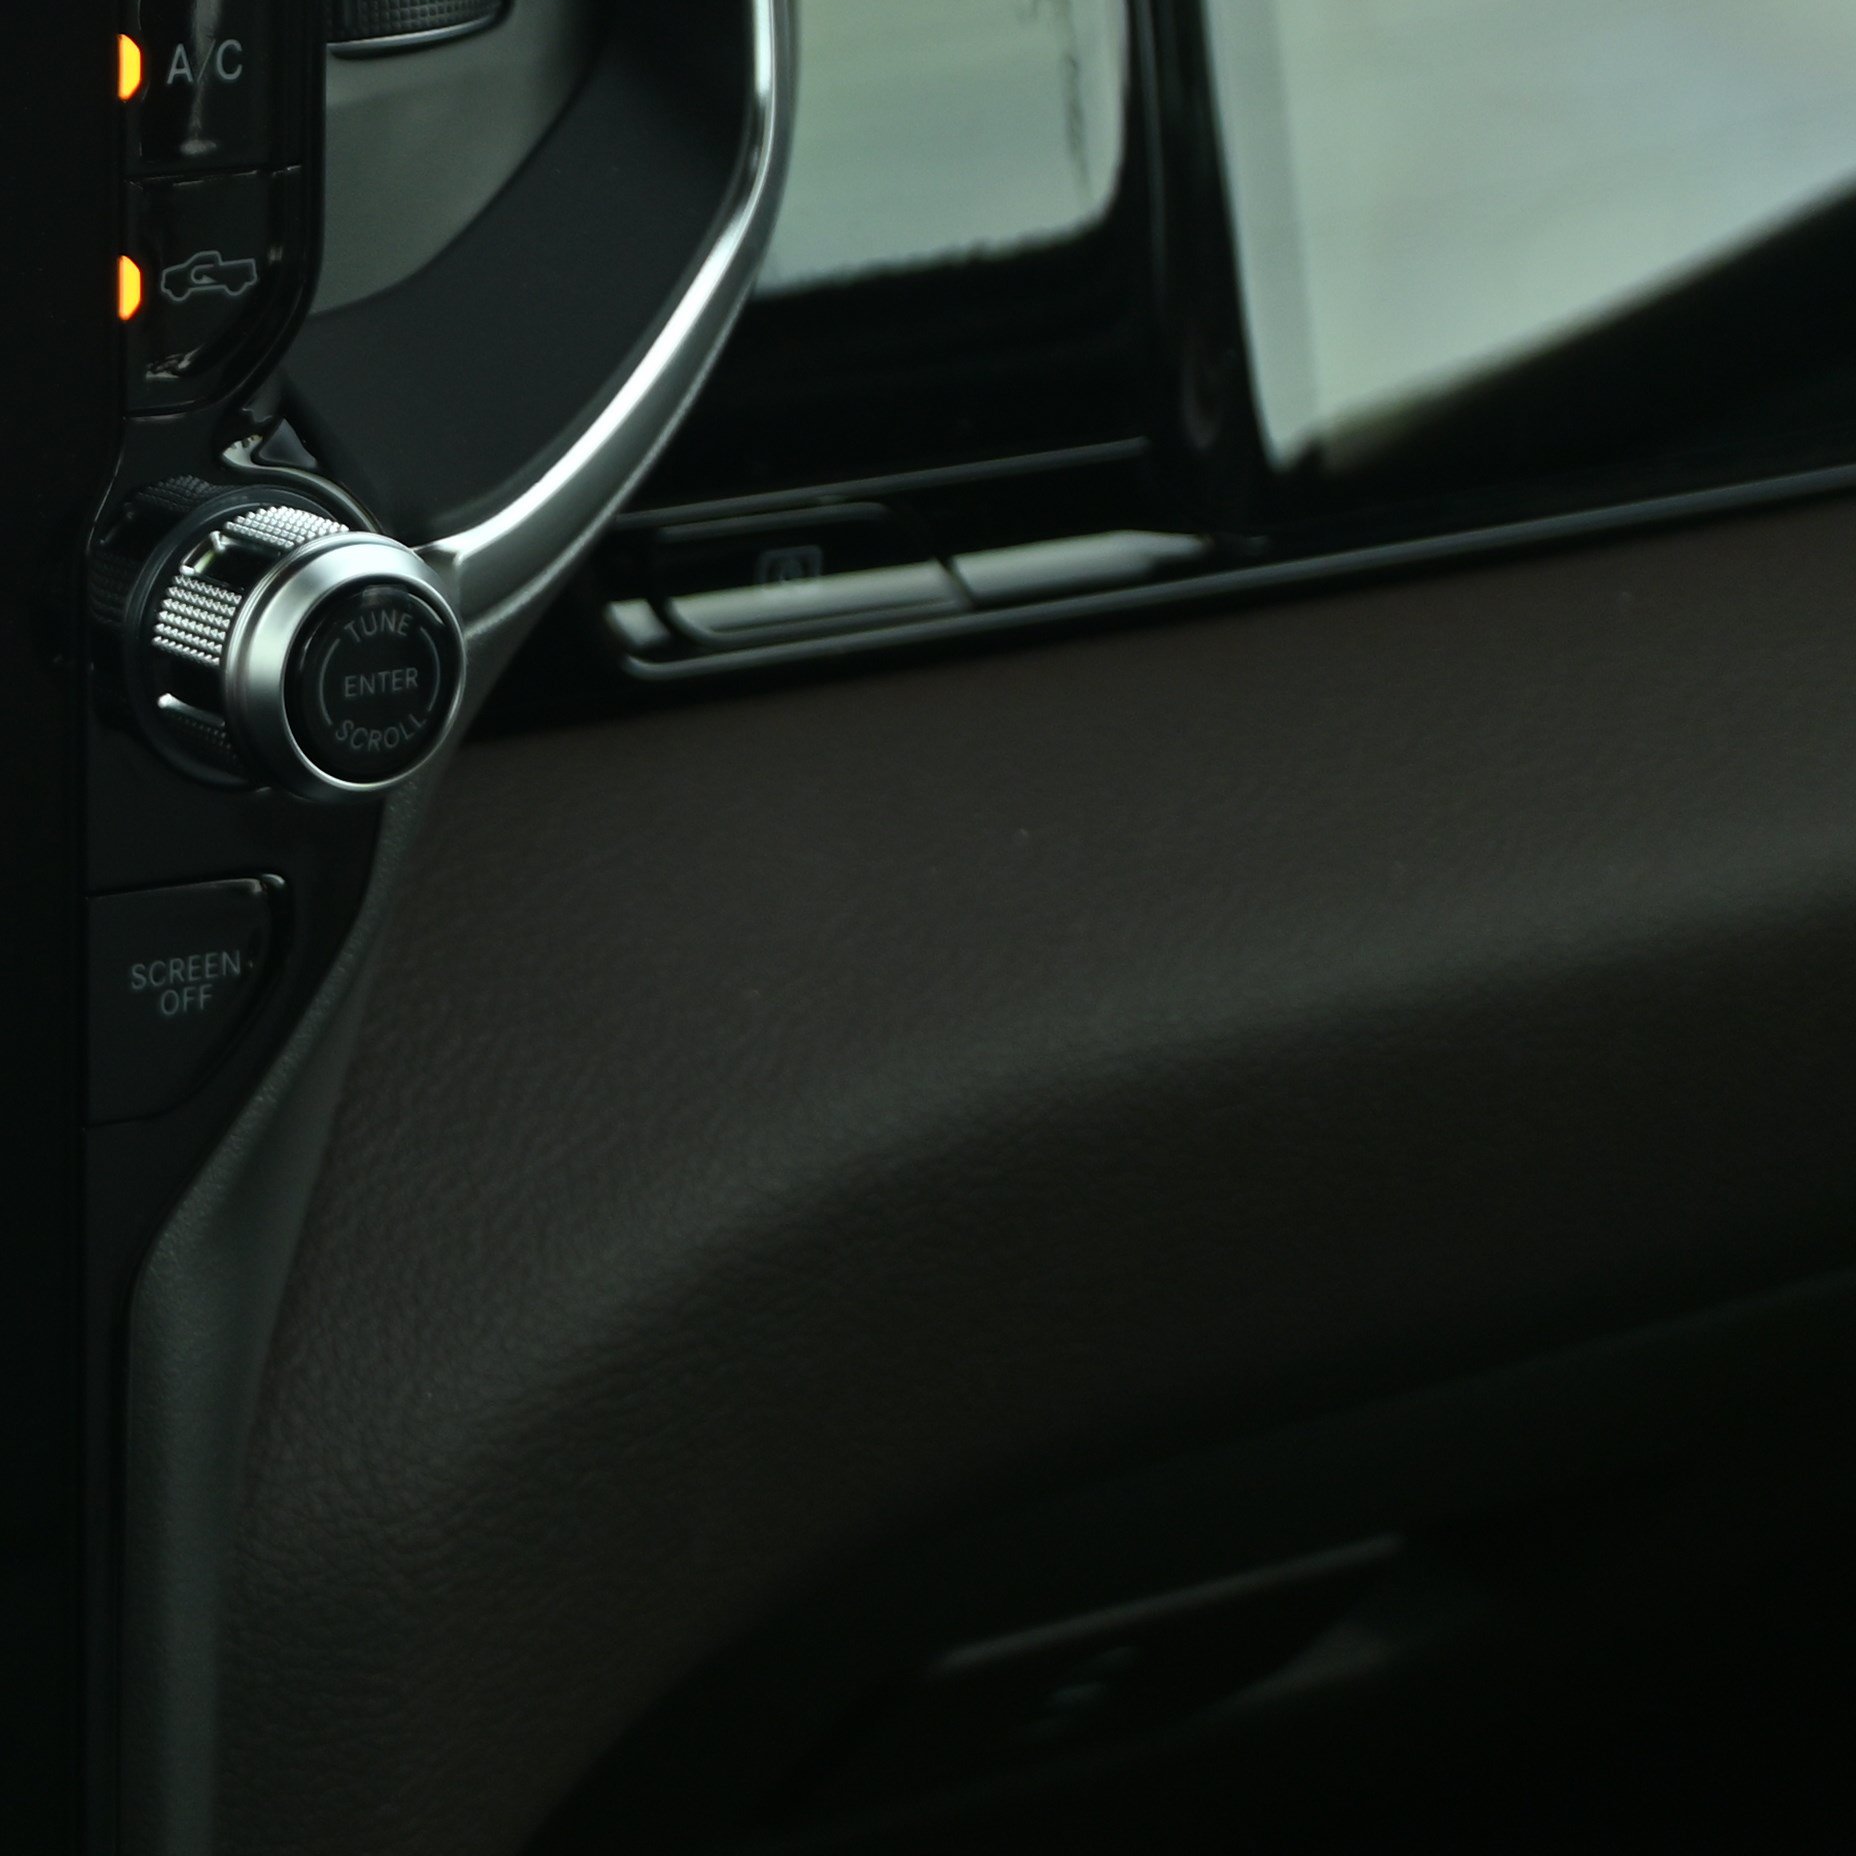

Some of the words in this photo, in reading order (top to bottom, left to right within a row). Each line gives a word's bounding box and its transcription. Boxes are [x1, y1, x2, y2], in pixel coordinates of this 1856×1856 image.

[168, 40, 243, 86] A/C
[344, 609, 413, 643] TUNE
[344, 667, 419, 698] ENTER
[336, 714, 428, 752] SCROLL
[131, 950, 241, 992] SCREEN
[160, 984, 213, 1016] OFF
